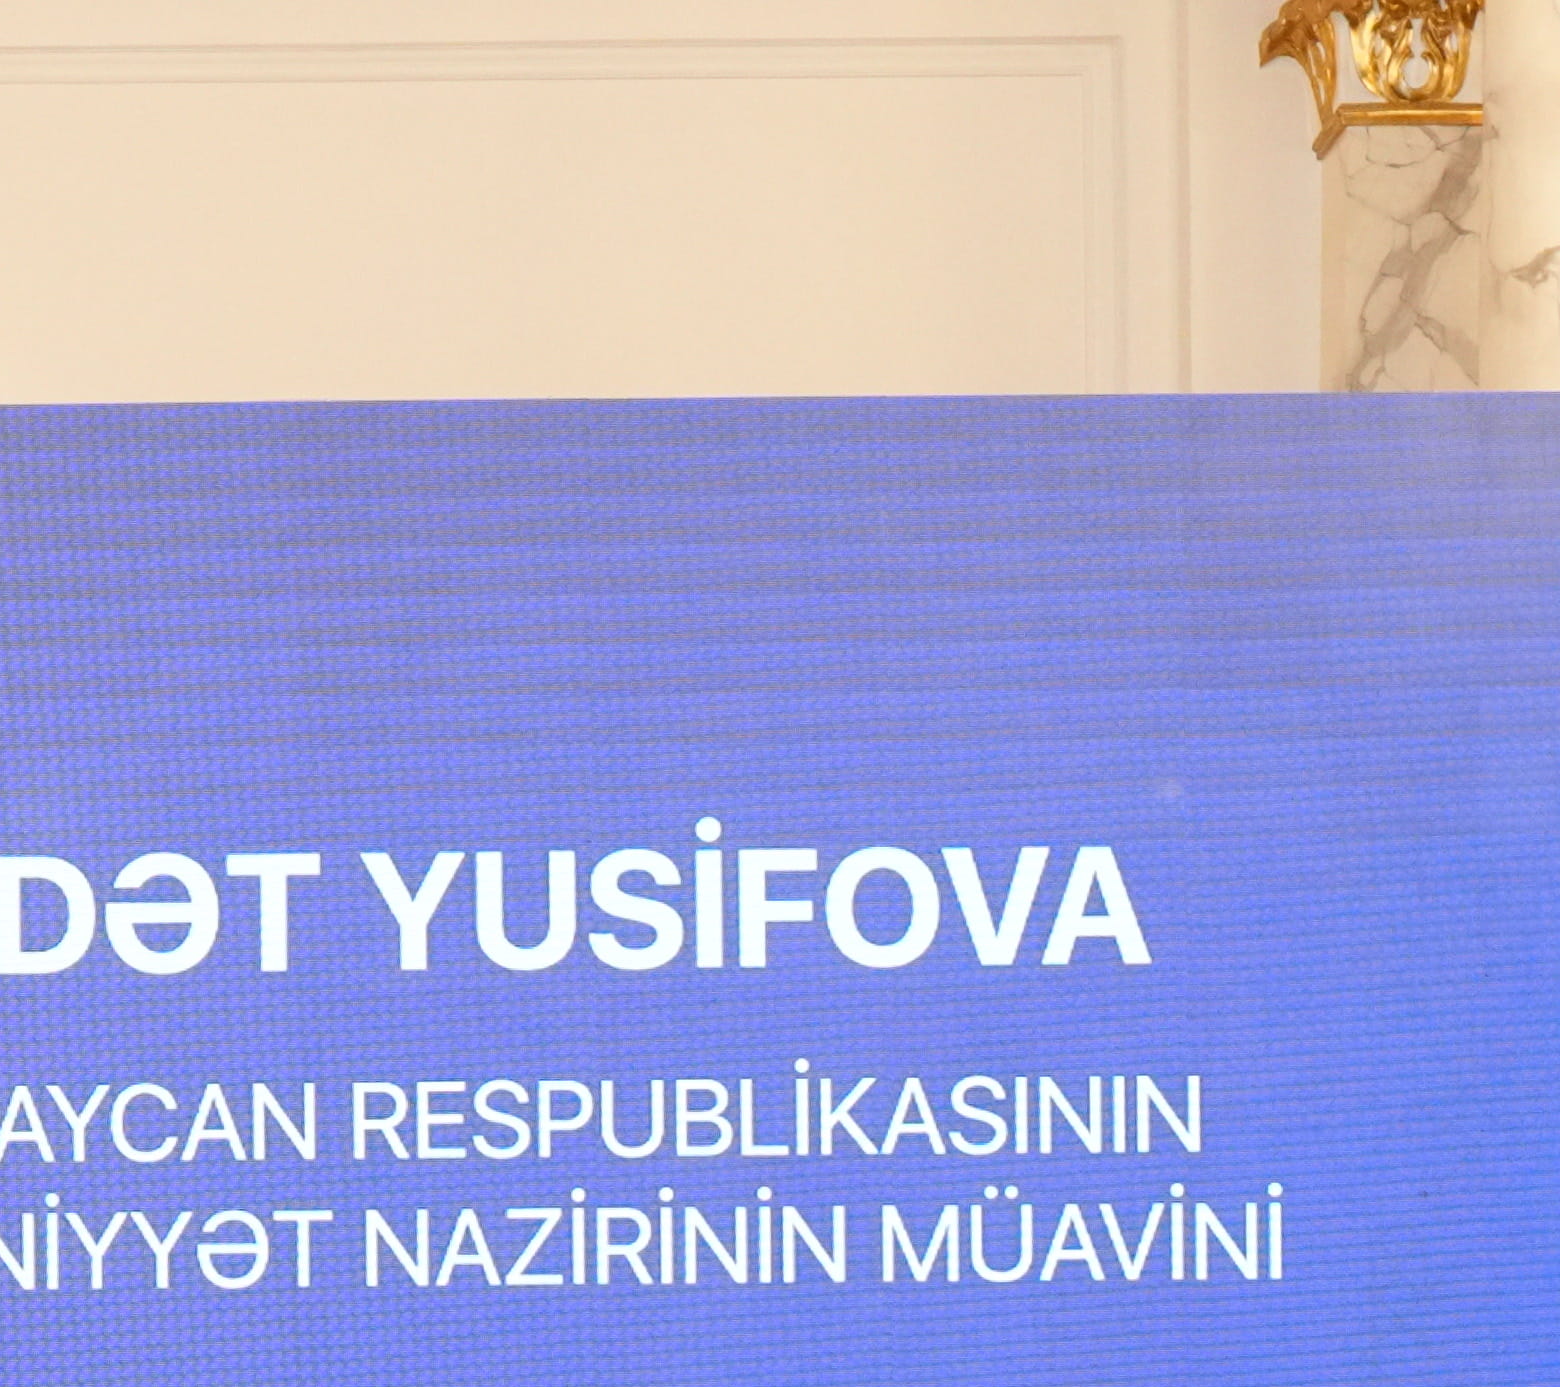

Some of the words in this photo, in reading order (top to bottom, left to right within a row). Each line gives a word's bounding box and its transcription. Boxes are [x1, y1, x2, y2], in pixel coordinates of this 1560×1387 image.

[360, 816, 1153, 971] YUSİFOVA
[352, 1058, 1202, 1160] RESPUBLİKASININ
[364, 1186, 847, 1287] NAZİRİNİN
[881, 1182, 1284, 1283] MÜAVİNİ
